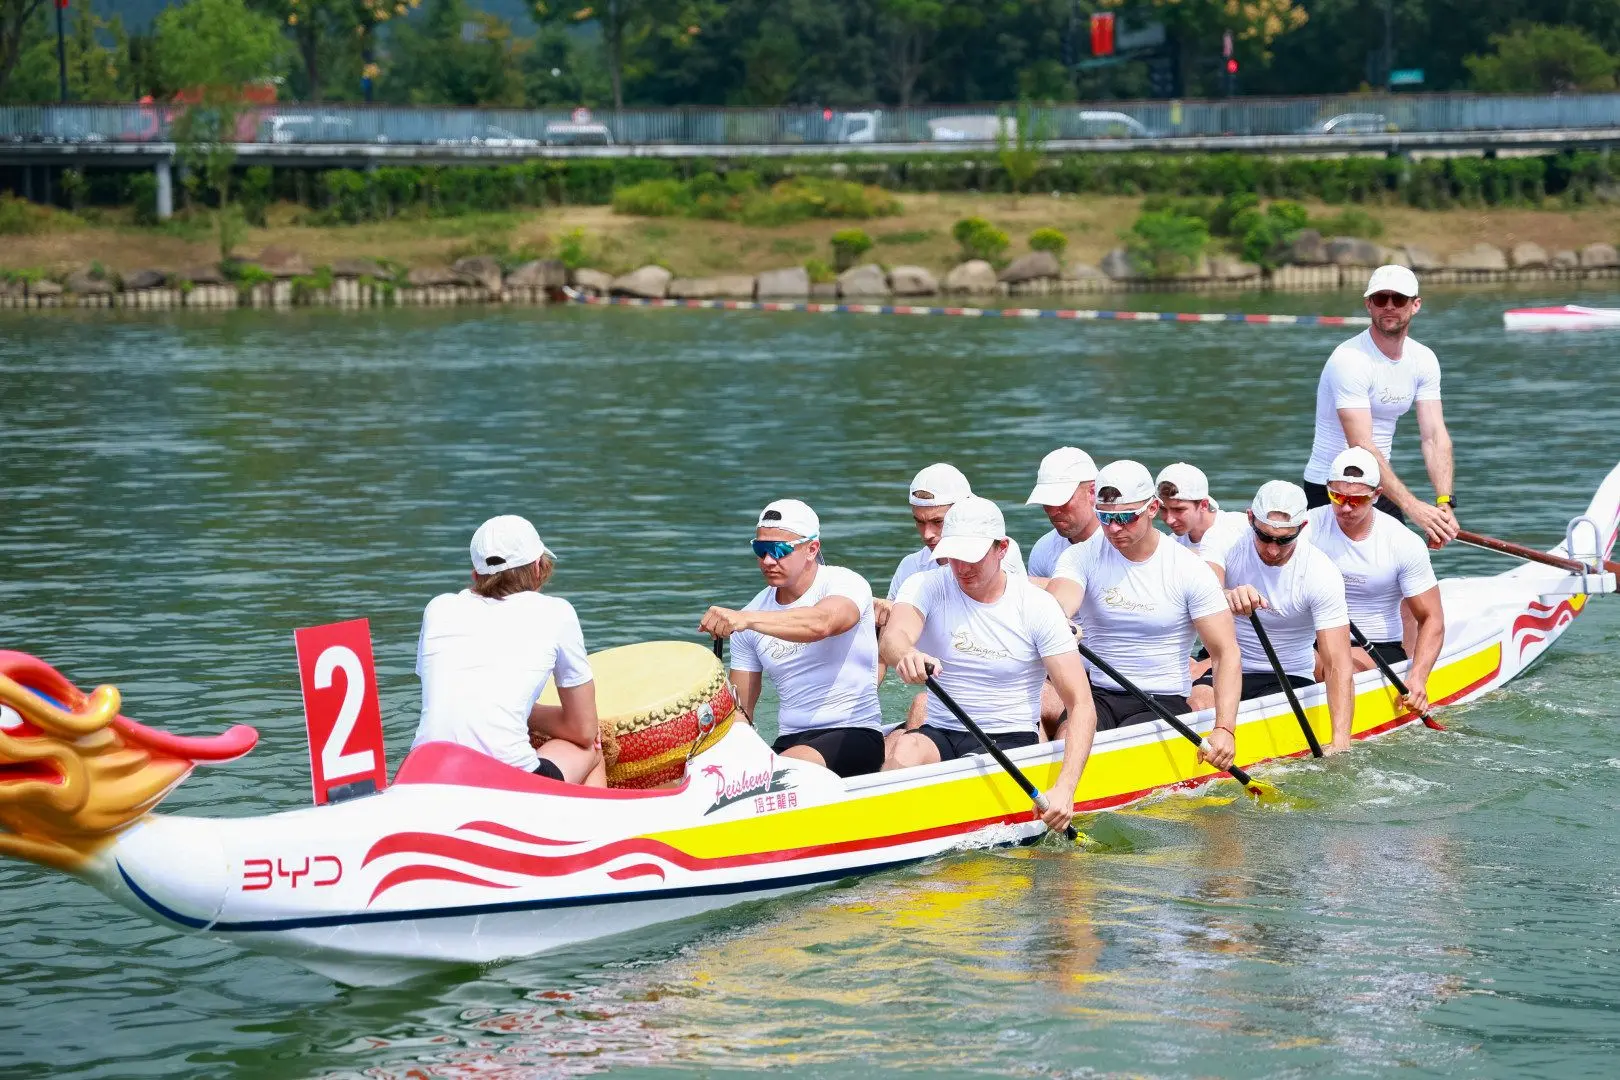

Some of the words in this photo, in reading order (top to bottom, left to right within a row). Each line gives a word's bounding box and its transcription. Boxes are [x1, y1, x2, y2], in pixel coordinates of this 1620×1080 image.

[313, 645, 376, 781] 2
[701, 753, 774, 805] Peisheng
[241, 855, 342, 891] BYD
